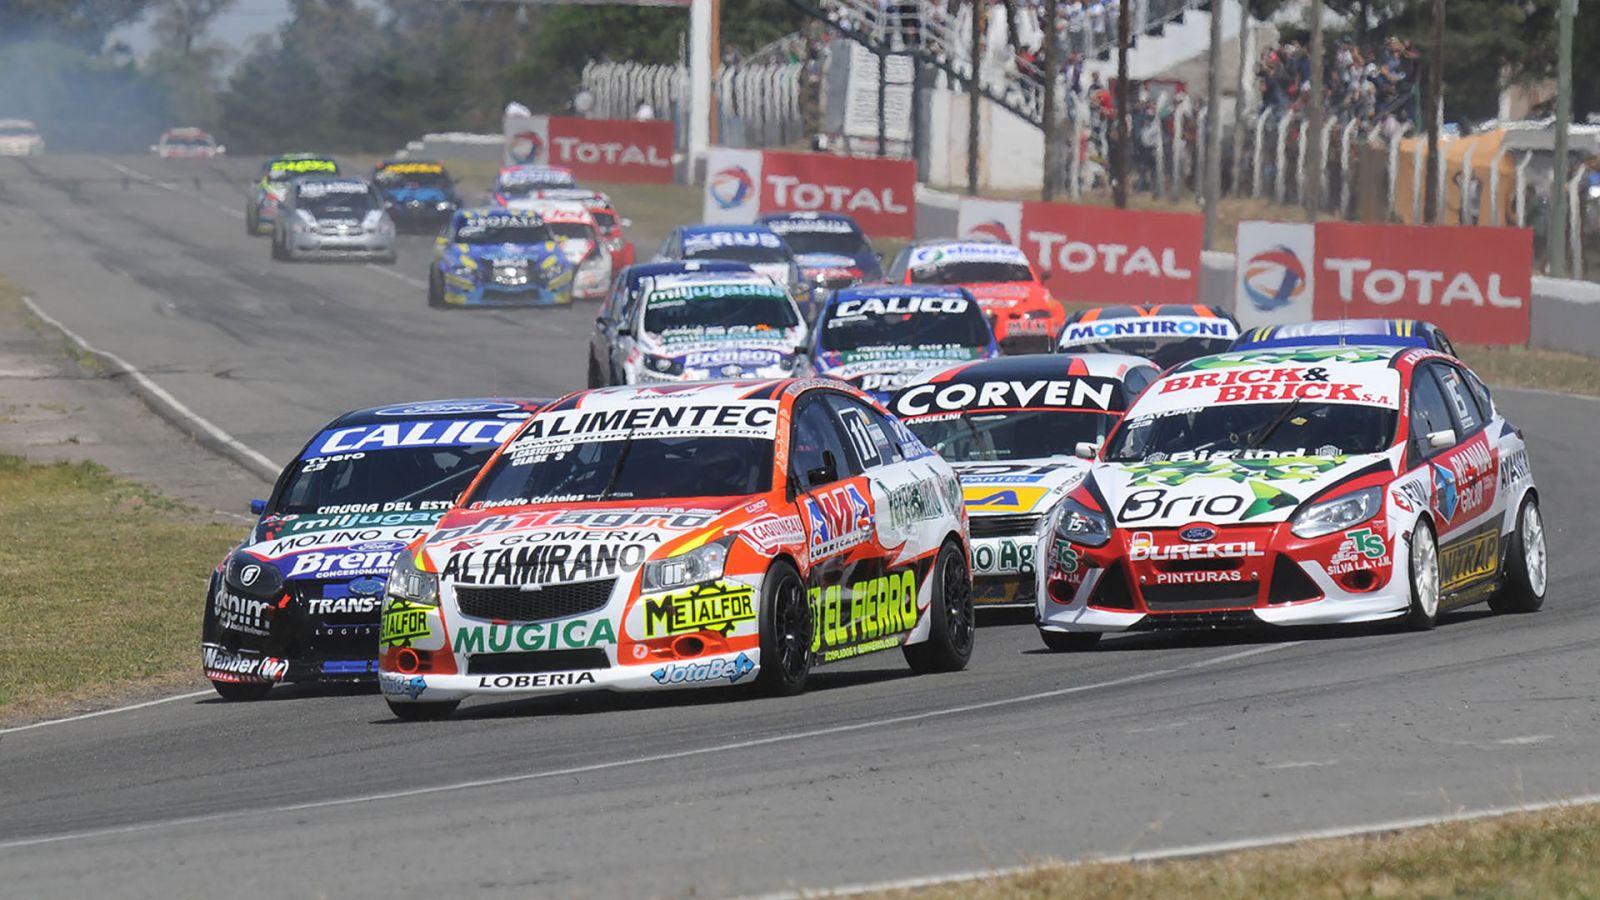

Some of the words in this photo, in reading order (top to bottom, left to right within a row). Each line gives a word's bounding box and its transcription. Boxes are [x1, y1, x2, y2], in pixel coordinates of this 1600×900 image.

[551, 138, 672, 167] TOTAL
[766, 175, 909, 214] TOTAL
[1027, 231, 1192, 280] TOTAL
[650, 284, 785, 303] miljugadas
[1325, 257, 1522, 309] TOTAL
[836, 297, 968, 317] CALICO
[1068, 316, 1229, 340] MONTIRONI
[1158, 368, 1304, 394] BRICK
[1303, 367, 1329, 382] &
[896, 378, 1115, 416] CORVEN
[1214, 384, 1366, 404] BRICK
[1362, 393, 1394, 406] S.A.
[515, 406, 777, 442] ALIMENTEC
[906, 413, 961, 425] ANGELINI
[849, 416, 877, 461] 11
[305, 452, 366, 465] Tuero
[512, 455, 548, 467] CLASE
[555, 453, 565, 461] 3
[317, 503, 378, 515] CIRUGIA
[382, 501, 408, 512] DEL
[483, 497, 529, 508] Rodolfo
[531, 493, 585, 505] Cristales
[1117, 489, 1243, 523] Brio
[804, 483, 872, 547] AMA
[1067, 517, 1085, 531] 15
[753, 518, 803, 540] CAQUINEAU
[1187, 528, 1209, 539] Ford
[268, 530, 382, 556] MOLINO
[358, 542, 396, 551] Ford
[1345, 527, 1386, 559] TS
[441, 544, 646, 585] ALTAMIRANO
[1055, 540, 1079, 573] TS
[1327, 562, 1354, 575] SILVA
[1440, 537, 1496, 584] NITRAP
[1156, 570, 1242, 584] PINTURAS
[308, 597, 382, 615] TRANS-
[645, 594, 753, 637] METALFOR
[824, 585, 848, 646] EL
[851, 569, 918, 642] FIERRO
[454, 618, 617, 654] MUGICA
[203, 647, 259, 675] Wander
[478, 671, 596, 688] LOBERIA
